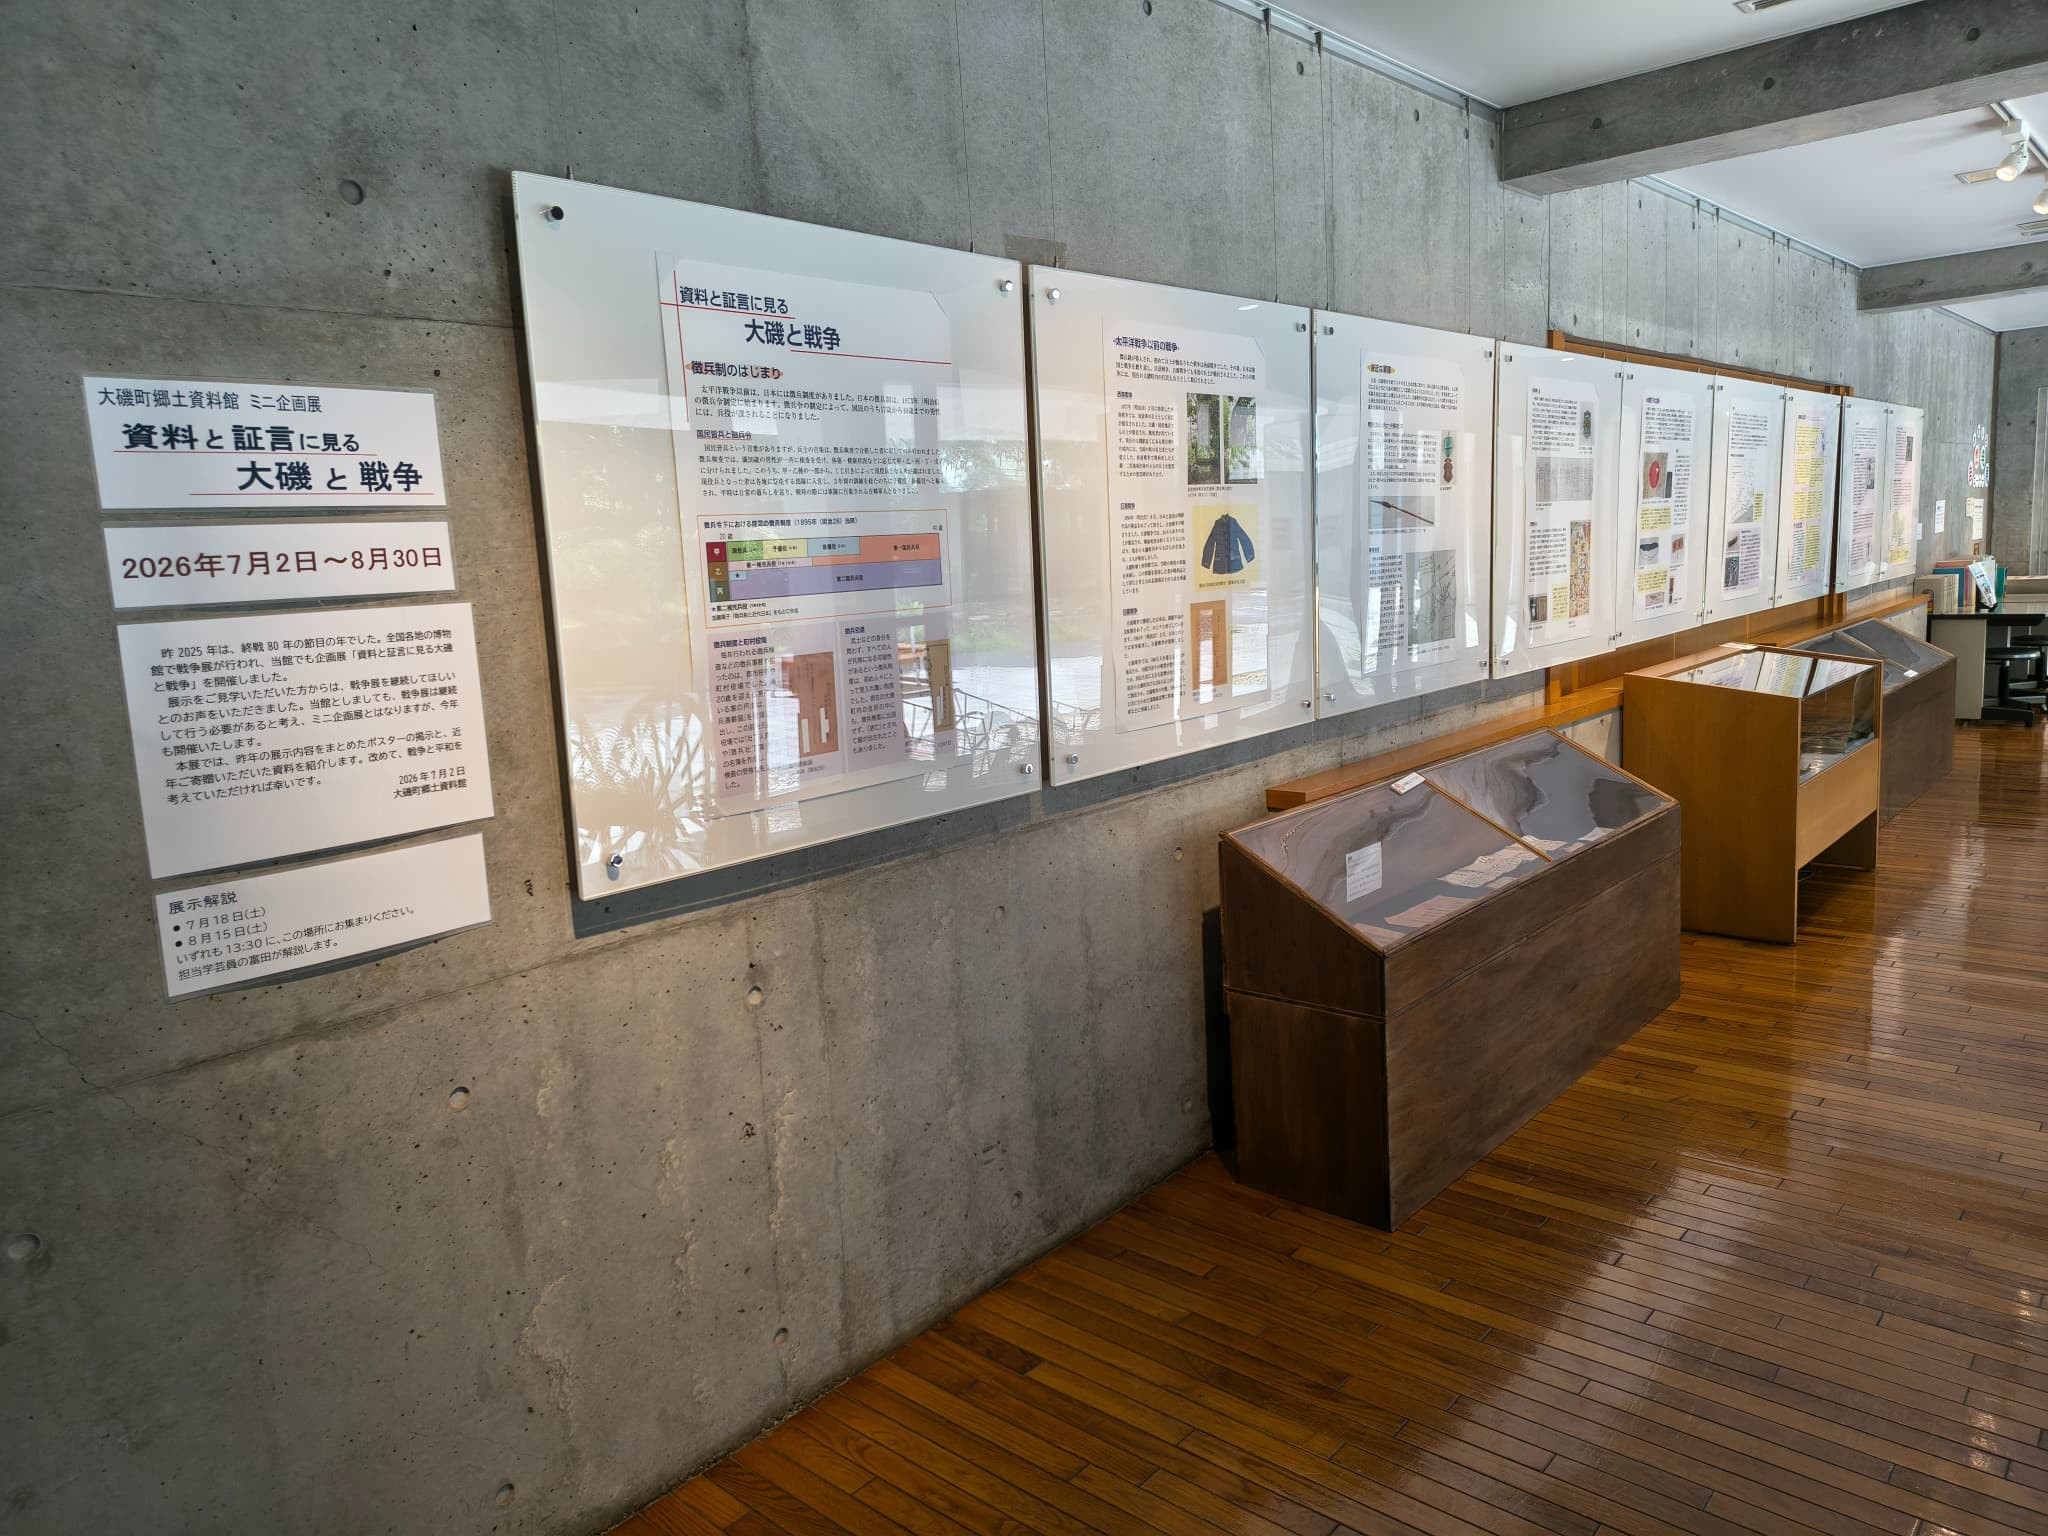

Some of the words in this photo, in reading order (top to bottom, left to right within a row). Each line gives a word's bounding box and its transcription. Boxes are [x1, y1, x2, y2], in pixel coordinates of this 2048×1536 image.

[680, 286, 788, 314] 資料と証言に見る
[744, 319, 841, 351] 大磯と戦争
[1115, 335, 1178, 352] 太平洋戦争以前の戦争
[691, 360, 782, 380] 徴兵制のはじまり
[97, 387, 239, 410] 大磯町郷土資料館
[250, 393, 322, 413] ミニ企画展
[121, 422, 360, 453] 資料と証言に見る
[697, 429, 752, 439] 国民皆兵と徴兵令
[236, 460, 423, 493] 大磯と戦争
[713, 636, 768, 649] 徴兵制度と町村役場
[150, 643, 453, 677] 館で戦争展が行われ、当館でも企画展「資料と証言に見る大磯
[153, 672, 289, 693] と戦争」を開催しました。
[168, 671, 456, 709] 展示をご見学いただいた方からは、戦争展を継続してほしい
[158, 685, 458, 725] とのお声をいただきました。当館としましても、戦争展は継続
[161, 700, 458, 741] して行う必要があると考え、ミニ企画展とはなりますが、今年
[162, 737, 264, 758] も開催いたします。
[176, 727, 462, 773] 本展では、昨年の展示内容をまとめたポスターの掲示と、近
[165, 741, 463, 789] 年ご寄贈いただいた資料を紹介します。改めて、戦争と平和を
[168, 776, 323, 805] 考えていただければ幸いです。
[393, 777, 467, 800] 大磯町郷土資料館
[168, 890, 238, 915] 展示解説
[178, 939, 339, 981] 担当学芸員の富田が解説します。
